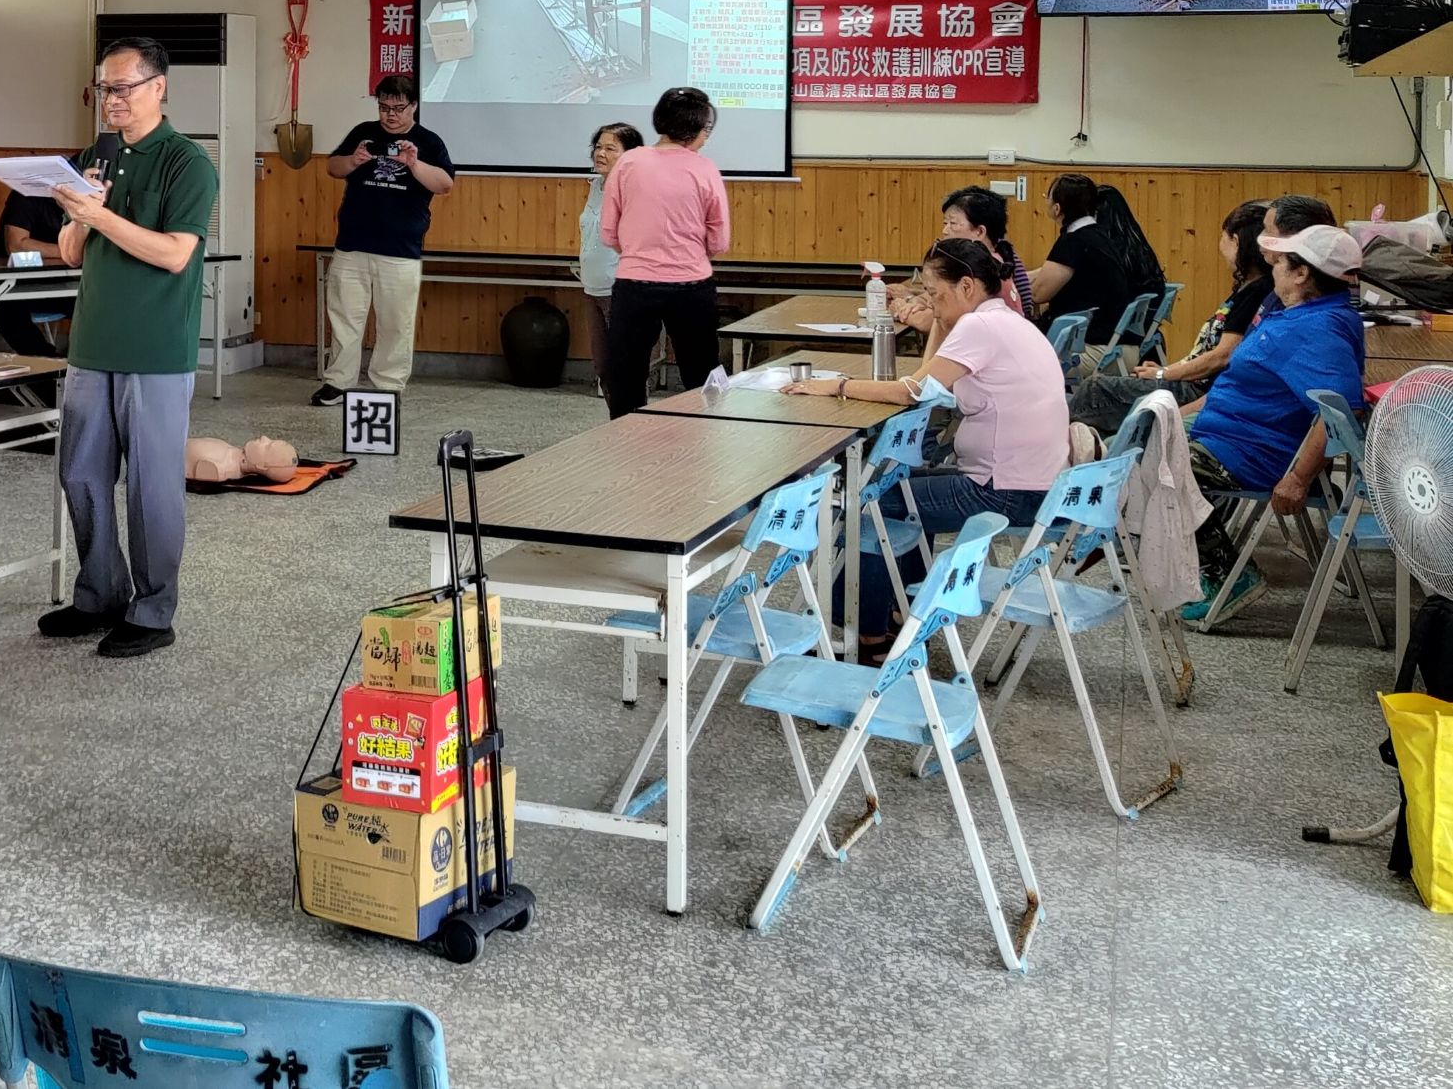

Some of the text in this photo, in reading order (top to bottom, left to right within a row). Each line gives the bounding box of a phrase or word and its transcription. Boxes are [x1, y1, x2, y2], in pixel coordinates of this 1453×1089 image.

[381, 2, 1027, 38] 新 區發展協會
[380, 43, 1026, 78] 關懷 項及防災救護訓練CPR宣導
[791, 82, 958, 99] 山區清泉社區發展協會
[349, 398, 393, 446] 招
[1062, 485, 1104, 507] 清泉
[768, 509, 806, 531] 清泉
[358, 735, 413, 760] 好結果
